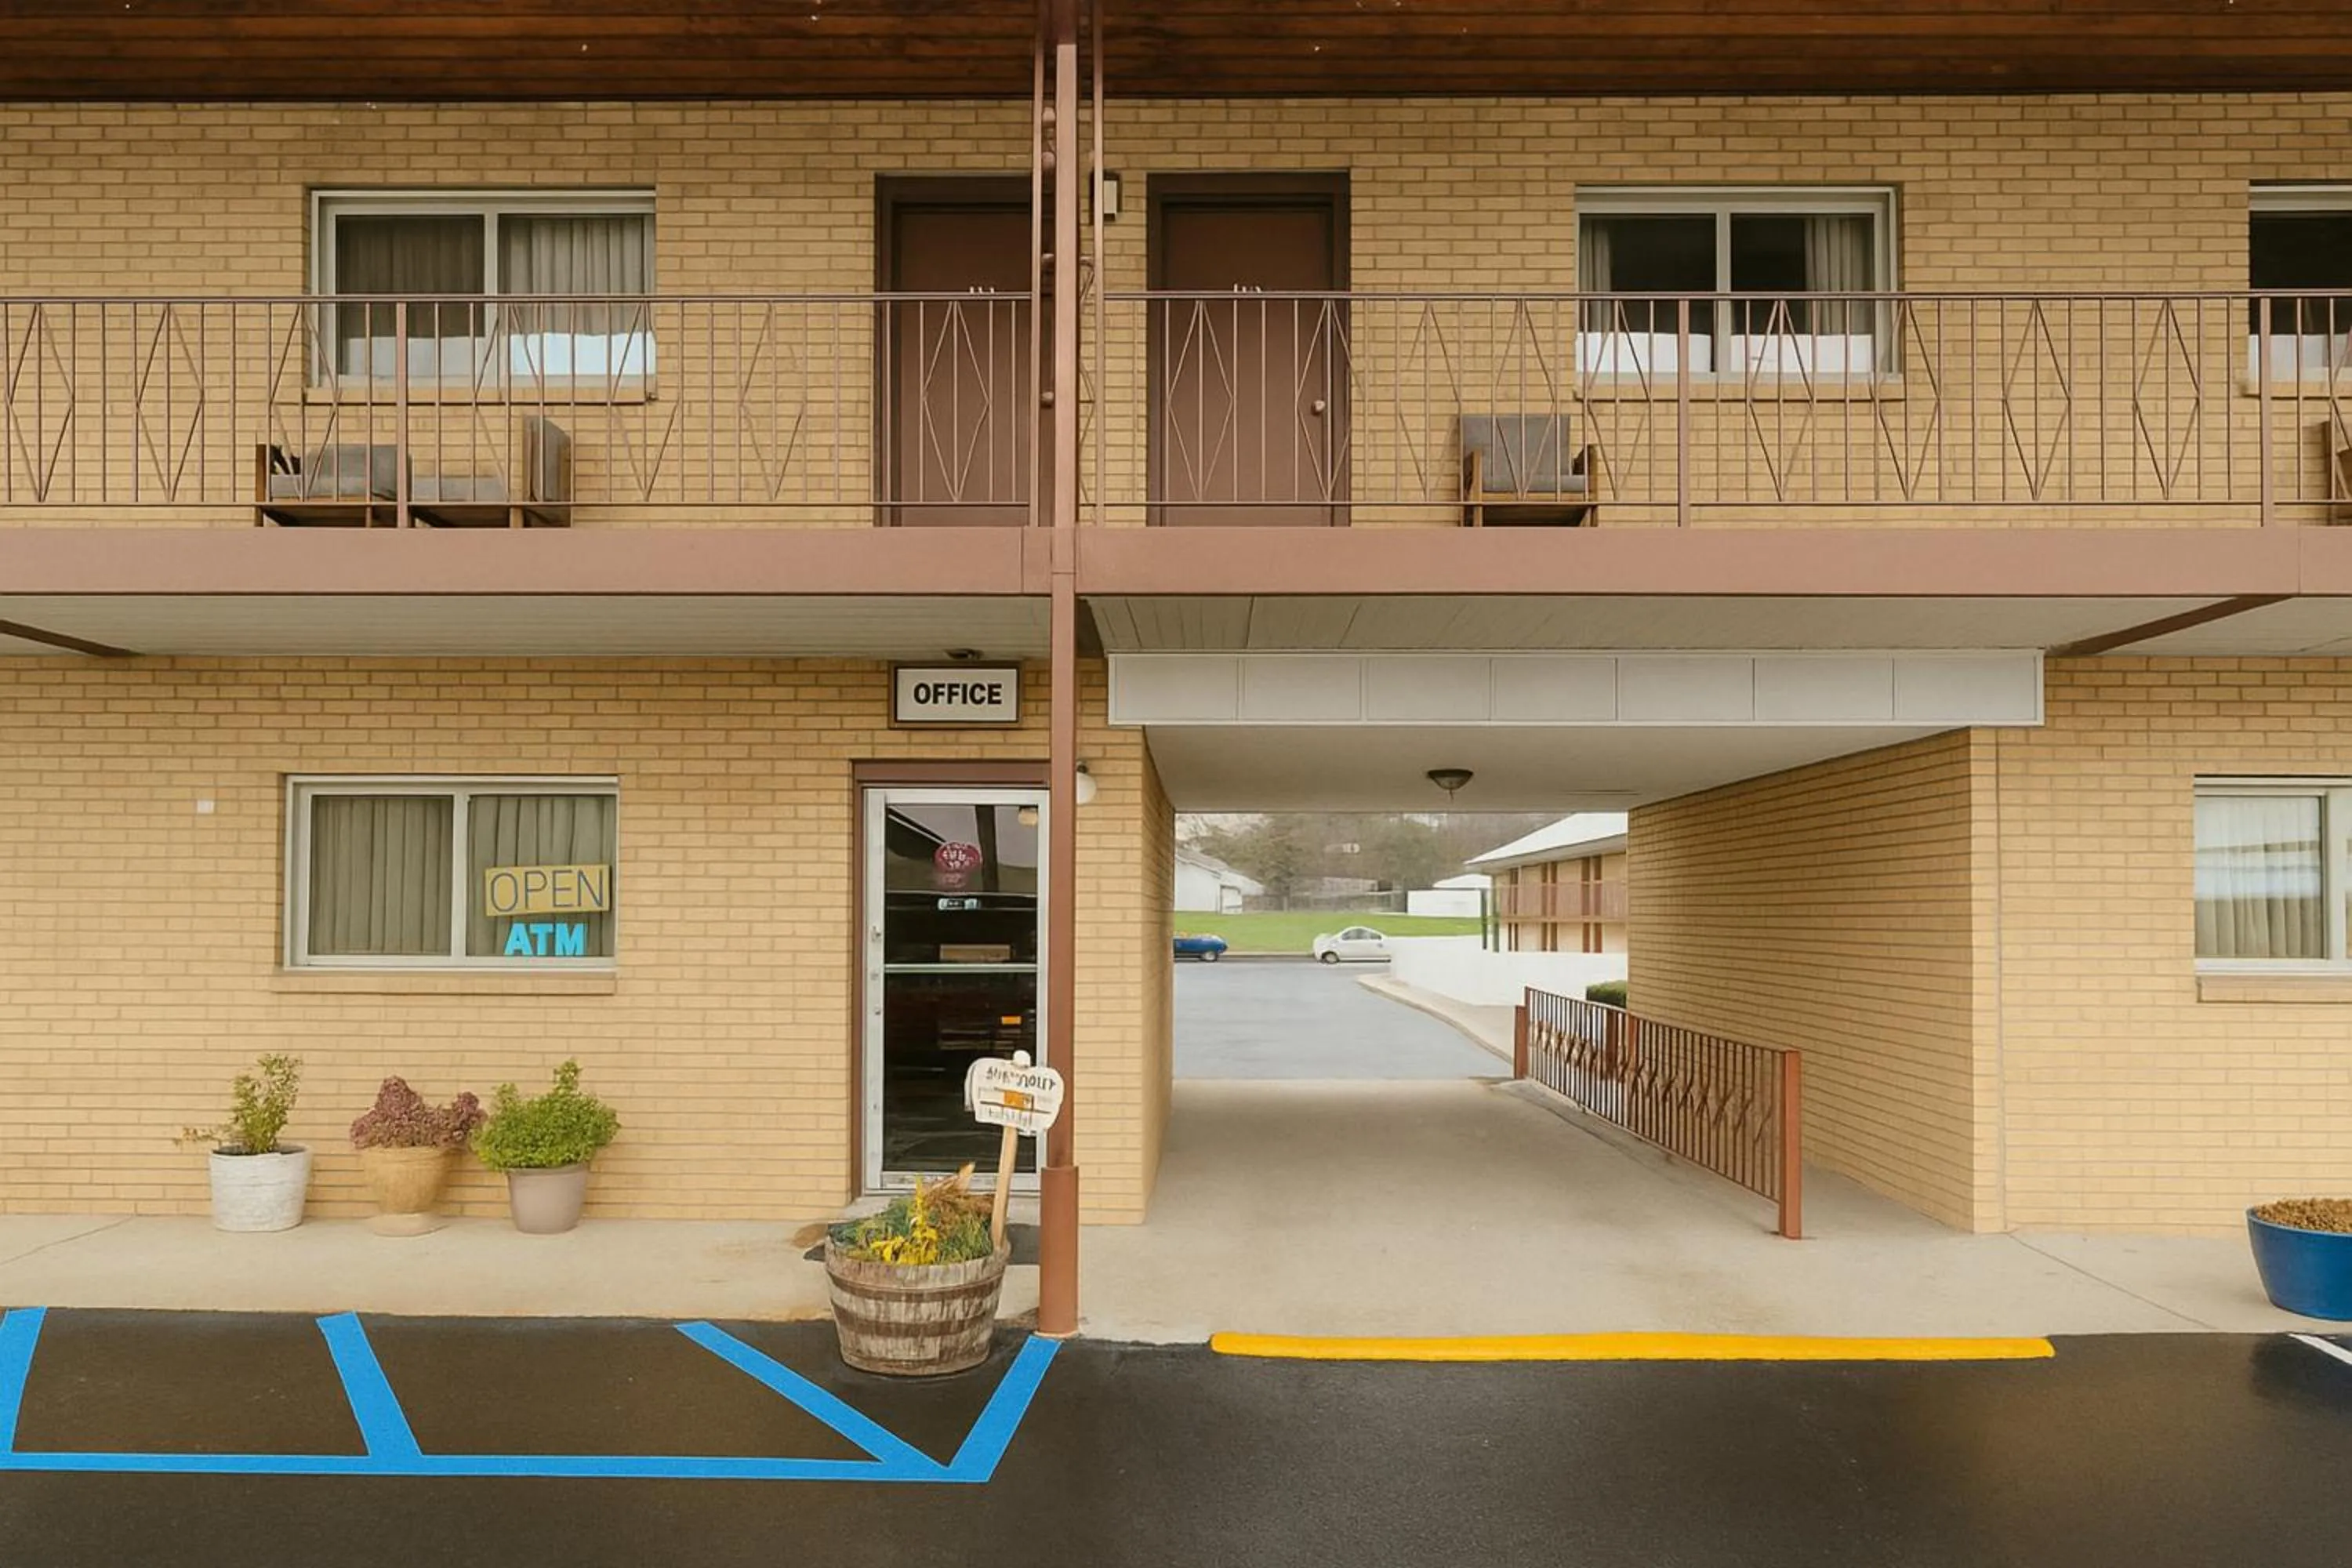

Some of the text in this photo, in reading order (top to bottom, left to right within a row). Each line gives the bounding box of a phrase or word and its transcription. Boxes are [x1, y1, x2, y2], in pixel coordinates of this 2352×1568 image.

[913, 683, 1002, 705] OFFICE
[490, 869, 604, 913] OPEN
[503, 922, 584, 956] ATM
